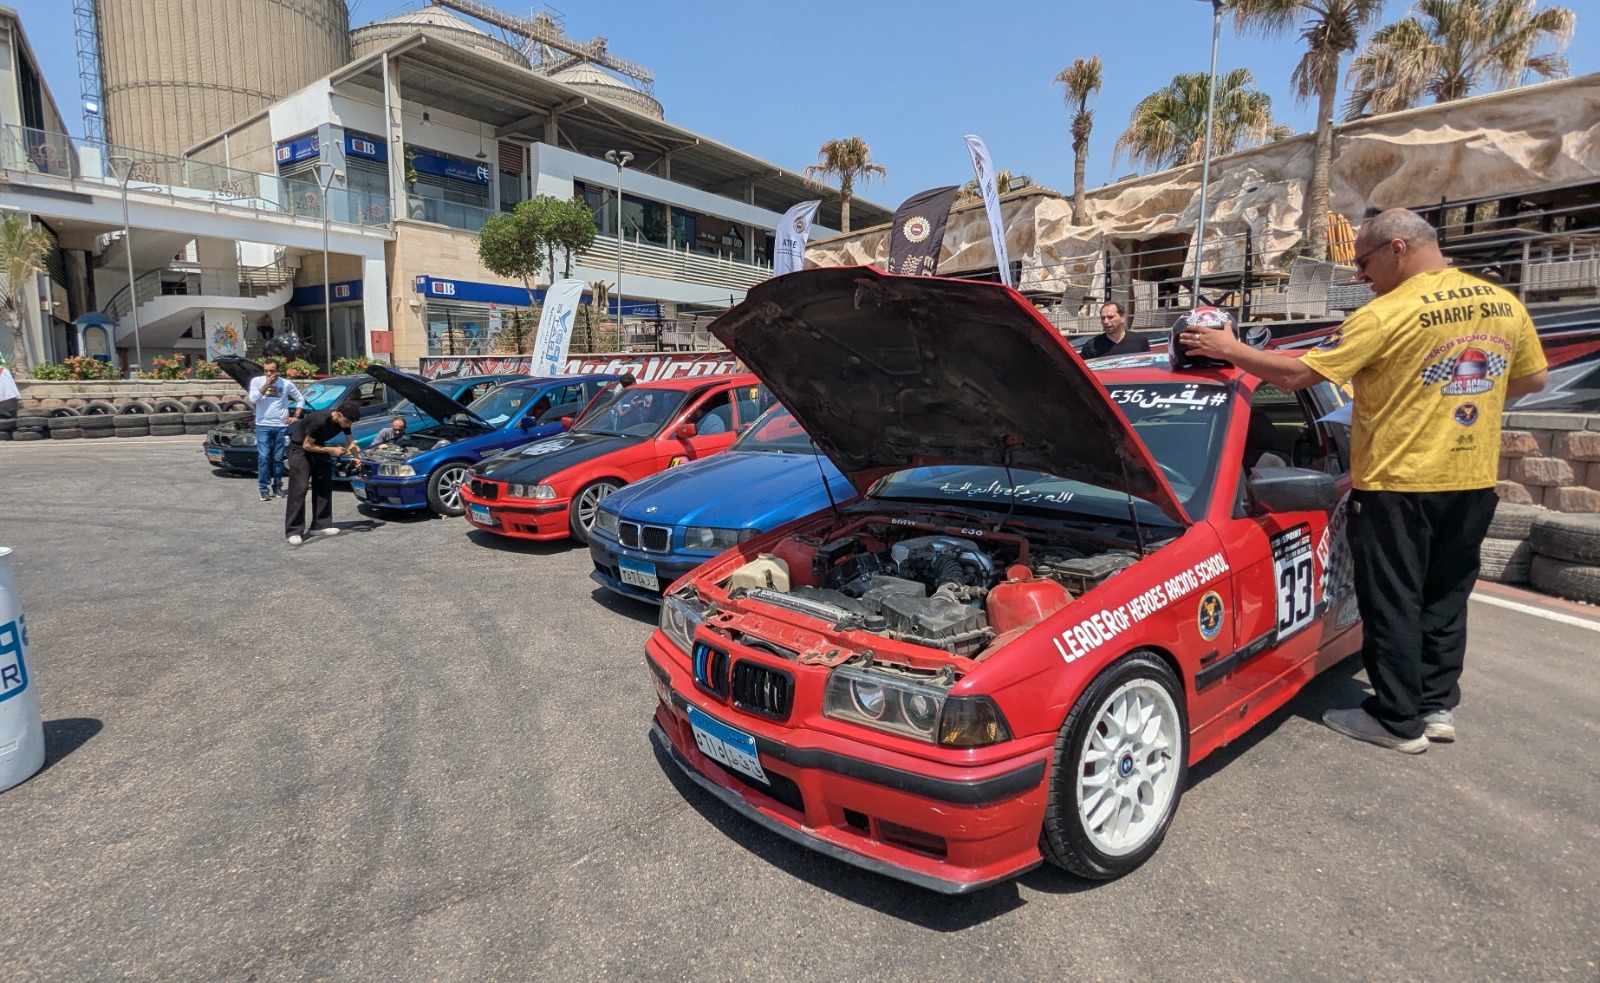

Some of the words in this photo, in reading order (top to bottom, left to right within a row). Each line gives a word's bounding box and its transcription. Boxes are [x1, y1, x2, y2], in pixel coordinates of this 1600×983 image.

[218, 189, 247, 199] ZONE
[296, 203, 321, 212] ZONE
[431, 281, 456, 296] CIB
[1420, 285, 1497, 304] LEADER
[1419, 304, 1475, 328] SHARIF
[1479, 302, 1514, 319] SAKR
[1279, 557, 1313, 633] 33
[1052, 609, 1118, 664] LEADER
[1113, 605, 1132, 632] OF
[1126, 584, 1168, 623] HEROES
[1164, 568, 1199, 602] RACING
[1194, 552, 1230, 585] SCHOOL
